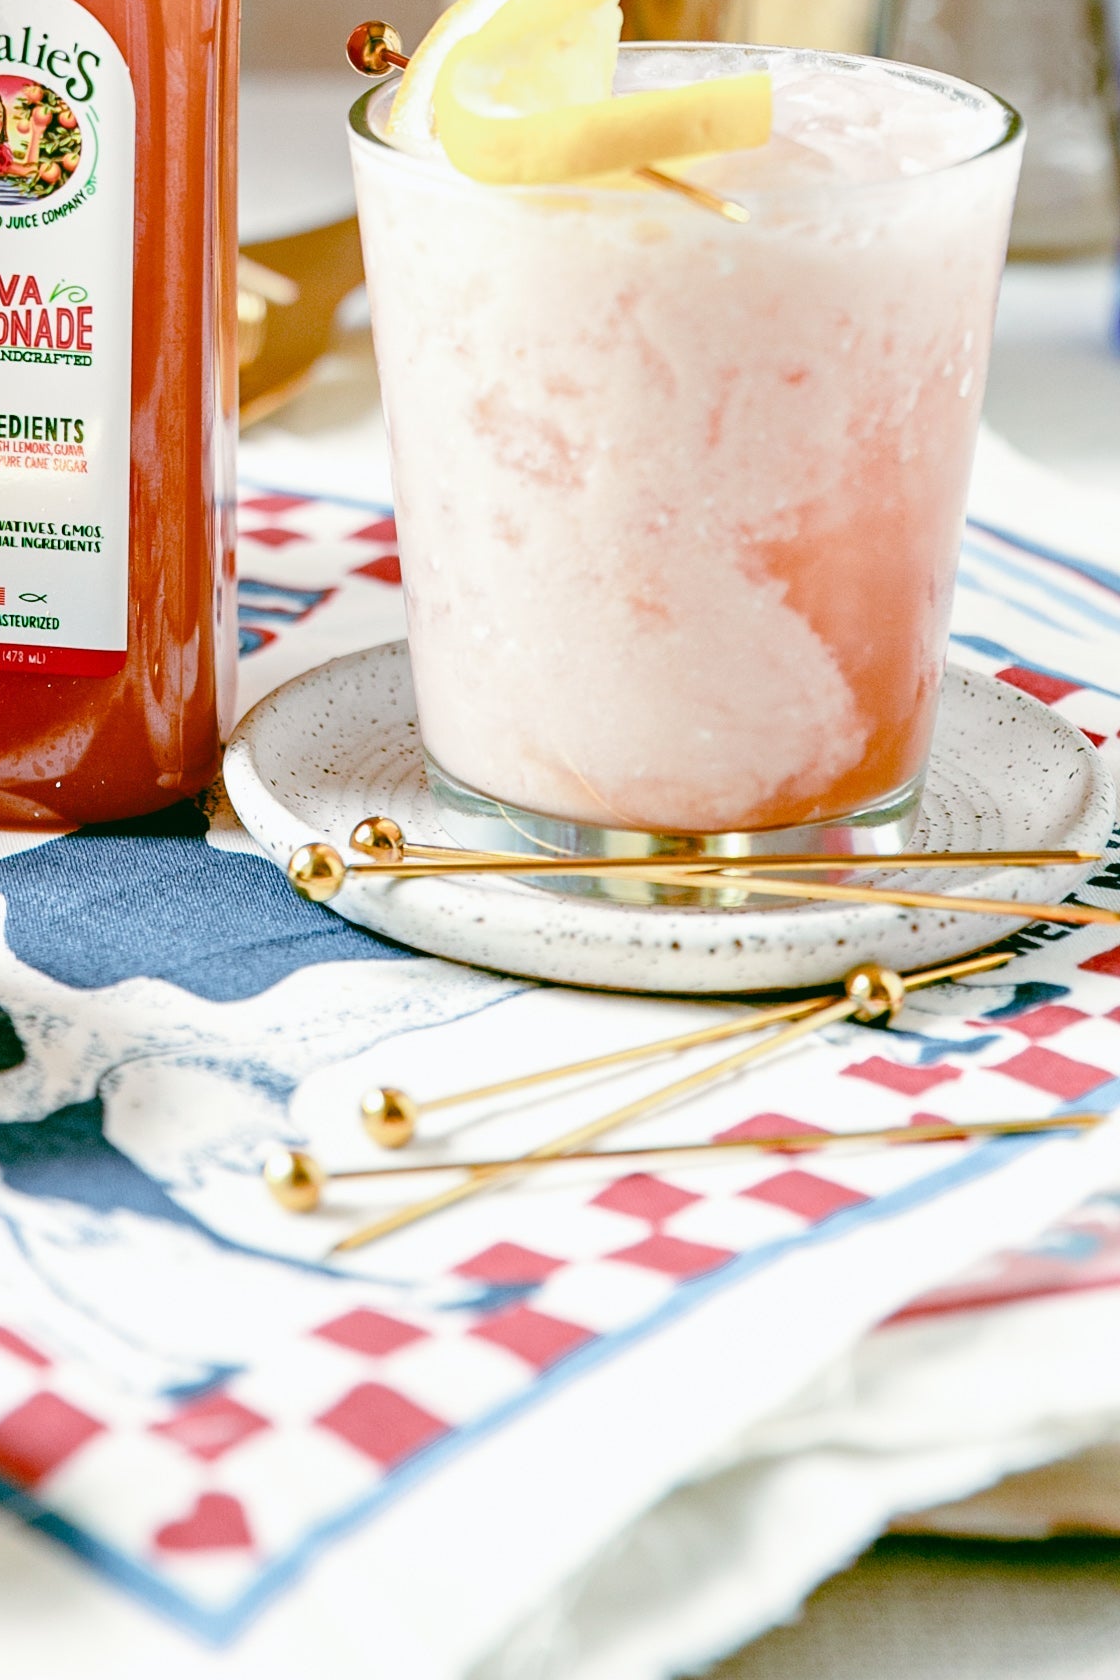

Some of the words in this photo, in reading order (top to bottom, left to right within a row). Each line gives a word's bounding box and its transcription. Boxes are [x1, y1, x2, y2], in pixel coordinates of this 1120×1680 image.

[5, 213, 39, 230] JUICE
[41, 189, 88, 225] COMPANY
[54, 444, 85, 457] GUAVA
[25, 456, 50, 470] CANE
[53, 458, 88, 474] SUGAR
[21, 537, 102, 554] INGREDIENTS
